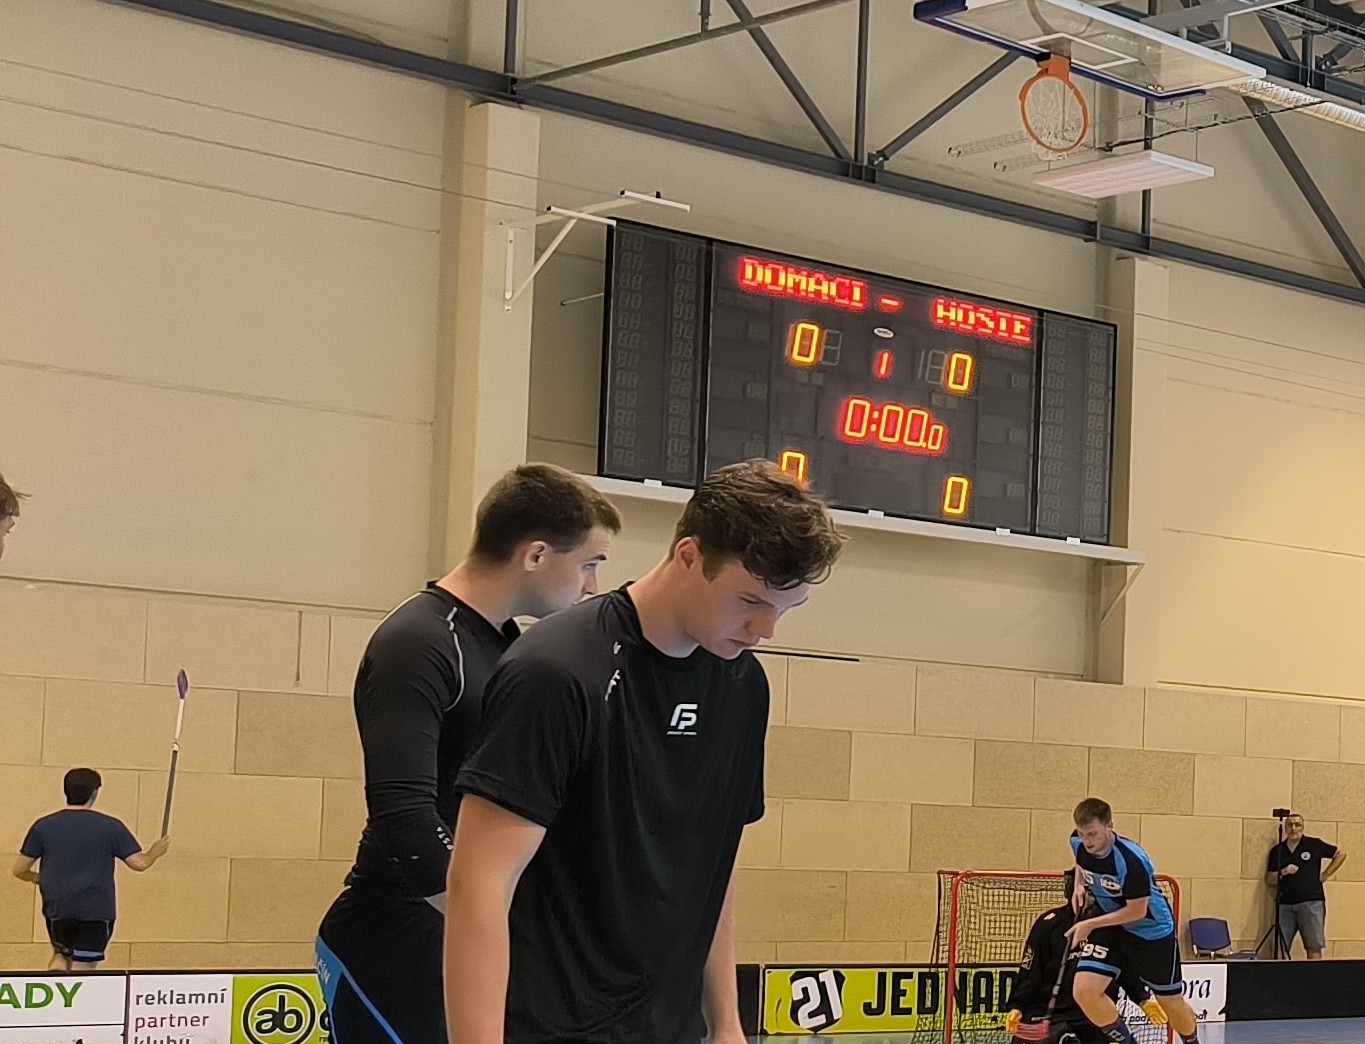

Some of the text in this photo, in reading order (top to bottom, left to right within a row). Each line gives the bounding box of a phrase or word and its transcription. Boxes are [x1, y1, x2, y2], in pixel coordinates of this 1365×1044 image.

[791, 322, 820, 364] 0
[947, 352, 974, 391] 0
[943, 475, 969, 515] 0
[1081, 943, 1109, 959] 95
[135, 988, 227, 1006] reklamní
[792, 970, 842, 1029] 21
[135, 1013, 209, 1032] partner
